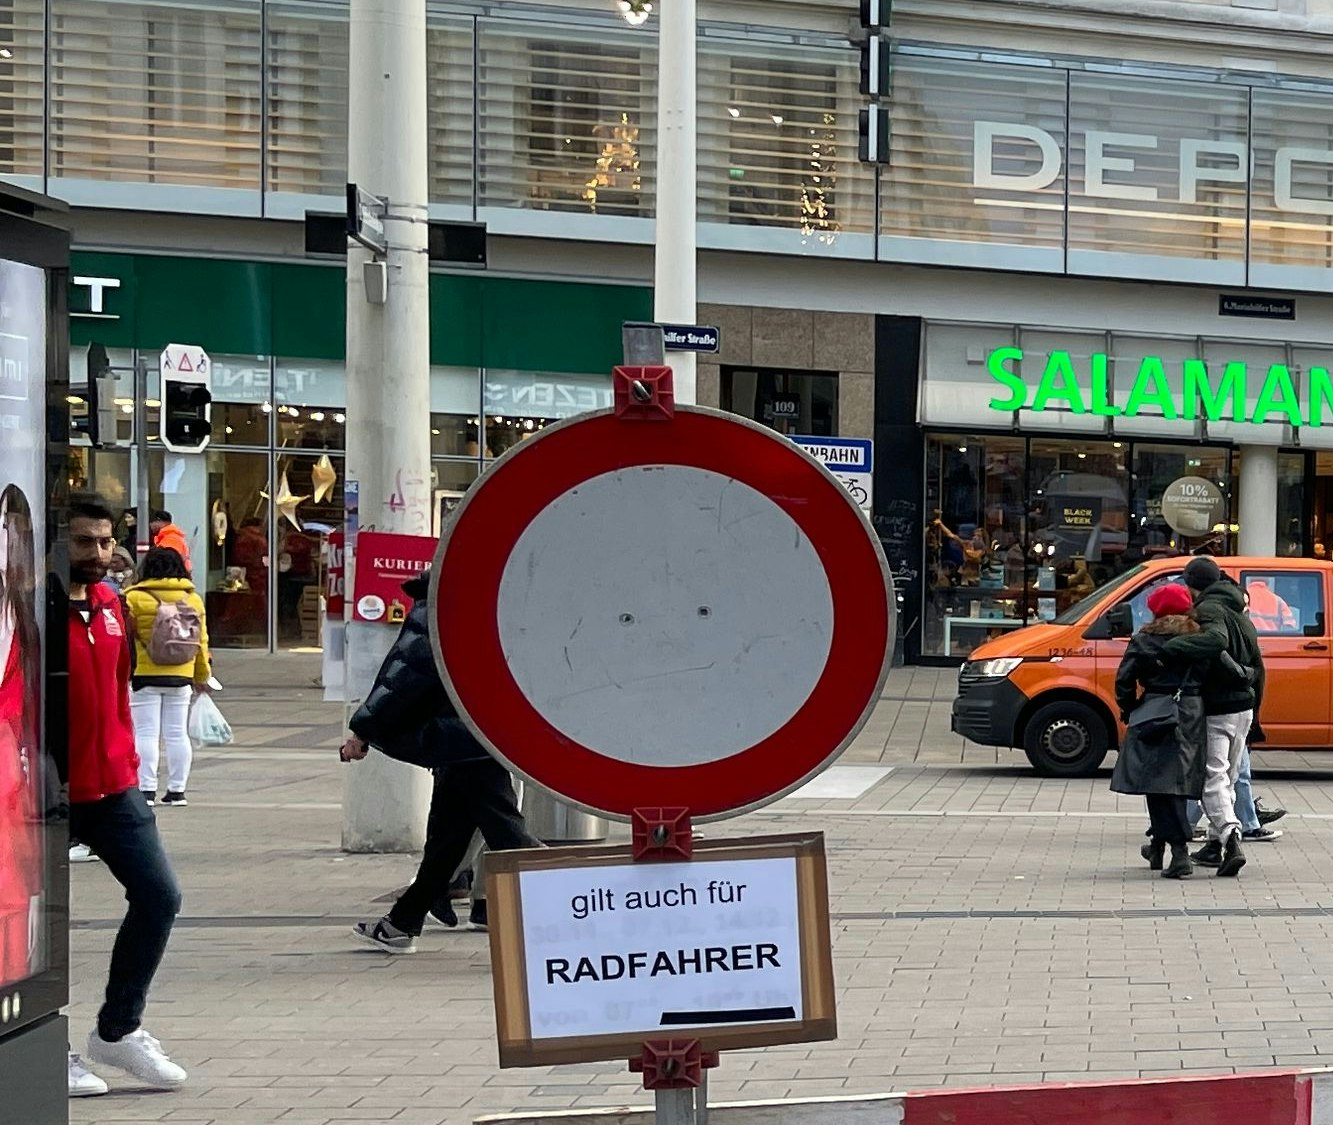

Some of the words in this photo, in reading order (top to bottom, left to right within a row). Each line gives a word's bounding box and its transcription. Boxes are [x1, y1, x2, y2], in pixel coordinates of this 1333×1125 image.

[775, 401, 795, 413] 109
[1180, 484, 1209, 496] 10%
[1064, 508, 1092, 517] BLACK
[1065, 516, 1092, 525] WEEK
[571, 888, 614, 919] gilt
[625, 883, 697, 909] auch
[706, 880, 747, 904] für
[546, 943, 781, 984] RADFAHRER
